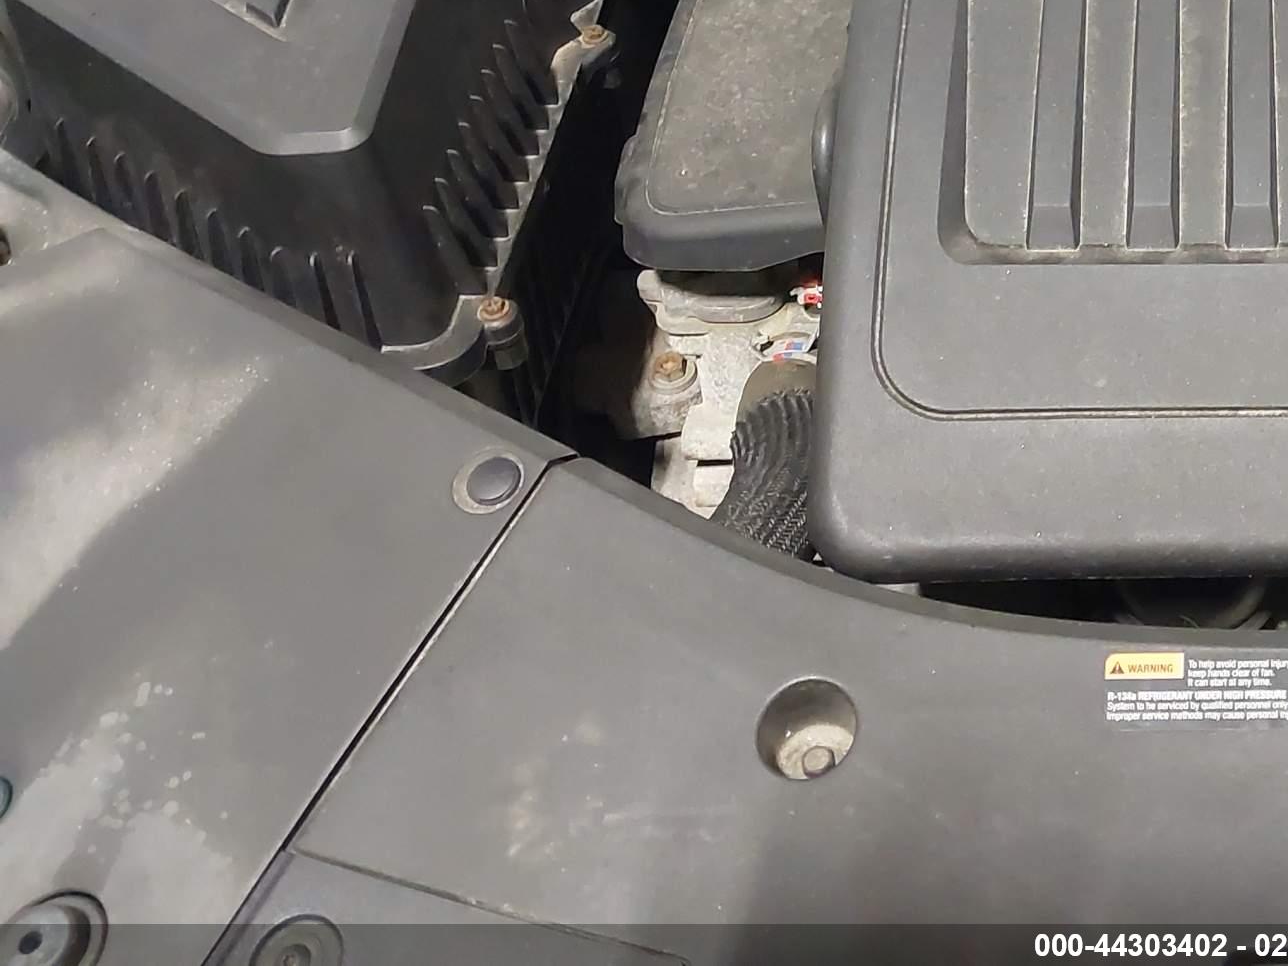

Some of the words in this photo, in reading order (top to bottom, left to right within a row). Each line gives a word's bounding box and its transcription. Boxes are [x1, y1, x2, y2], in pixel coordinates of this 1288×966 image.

[1128, 664, 1173, 673] WARNING
[1188, 659, 1197, 668] To
[1198, 660, 1215, 670] help
[1216, 660, 1236, 668] avoid
[1237, 660, 1269, 669] personal
[1188, 669, 1206, 678] keep
[1207, 669, 1230, 677] hands
[1231, 668, 1250, 677] clear
[1251, 668, 1260, 677] of
[1261, 668, 1275, 677] fan.
[1210, 678, 1227, 686] start
[1229, 678, 1236, 686] at
[1238, 679, 1252, 688] any
[1253, 678, 1272, 686] time.
[1107, 691, 1136, 701] R-134a
[1138, 691, 1193, 701] REFRIGERANT
[1194, 690, 1222, 700] UNDER
[1223, 690, 1243, 700] HIGH
[1245, 689, 1287, 699] PRESSURE
[1107, 702, 1135, 711] System
[1136, 702, 1144, 710] to
[1146, 702, 1155, 710] be
[1157, 701, 1188, 710] serviced
[1190, 702, 1199, 711] by
[1201, 701, 1233, 710] qualified
[1234, 701, 1271, 710] personnel
[1106, 713, 1141, 721] Improper
[1142, 712, 1169, 720] service
[1170, 712, 1203, 720] methods
[1204, 712, 1220, 721] may
[1246, 710, 1278, 720] personal
